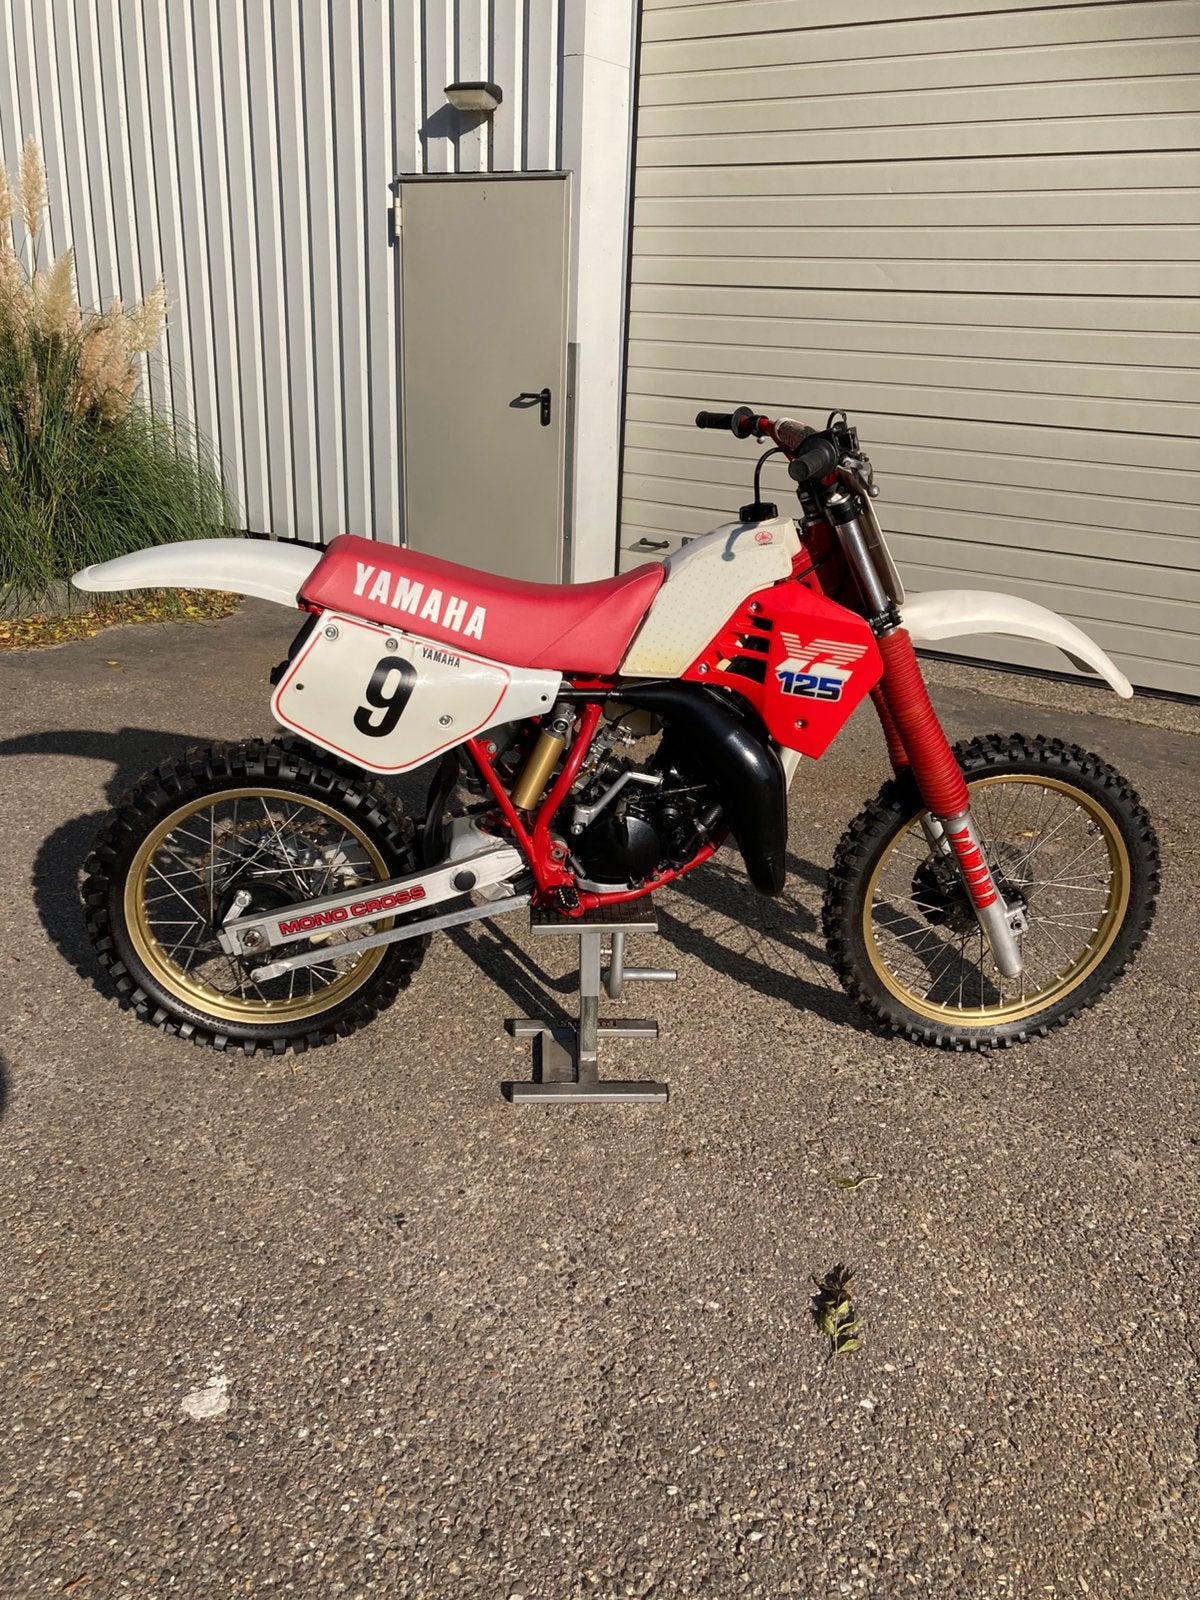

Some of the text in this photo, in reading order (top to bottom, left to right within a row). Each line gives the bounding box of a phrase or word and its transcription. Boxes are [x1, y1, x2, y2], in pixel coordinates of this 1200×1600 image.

[353, 562, 486, 640] YAMAHA
[422, 647, 461, 668] YAMAHA
[775, 670, 845, 702] 125
[353, 656, 418, 737] 9
[950, 827, 997, 908] YAMAHA
[278, 885, 426, 935] MONO CROSS
